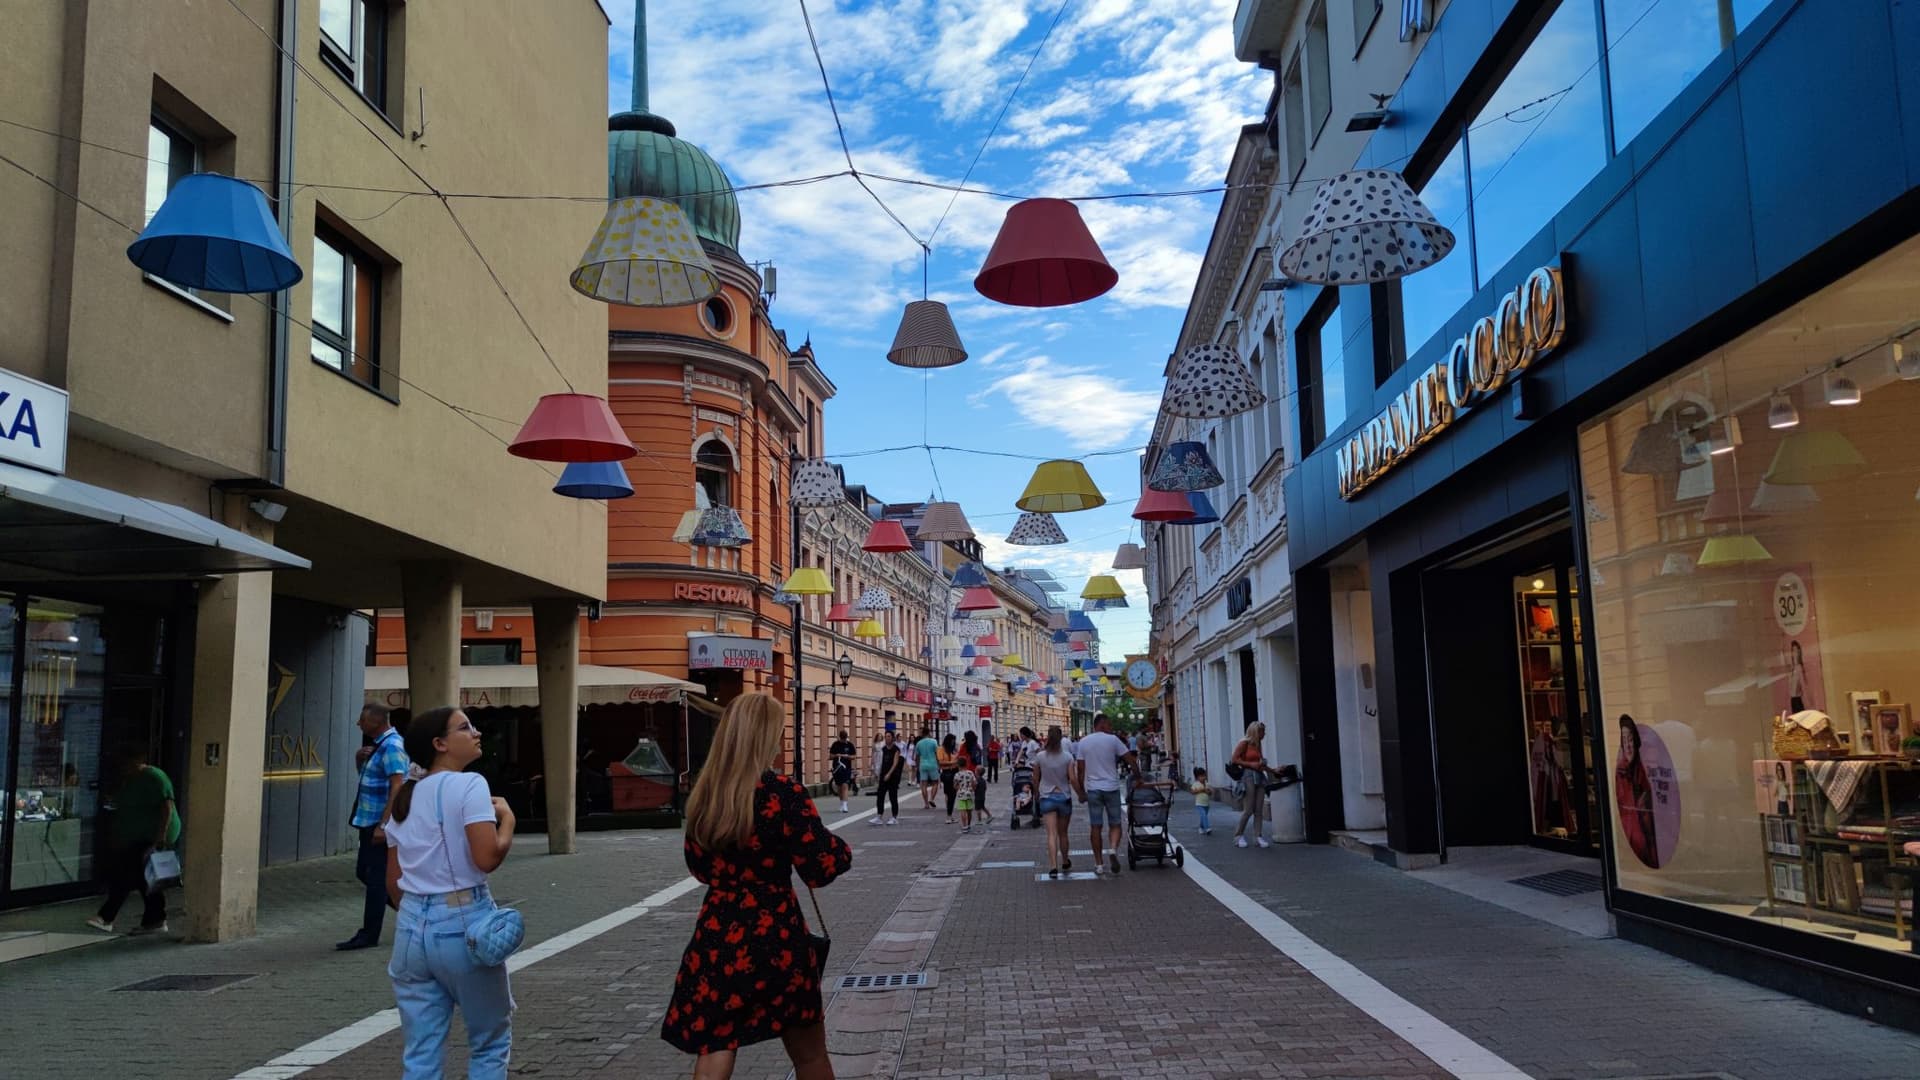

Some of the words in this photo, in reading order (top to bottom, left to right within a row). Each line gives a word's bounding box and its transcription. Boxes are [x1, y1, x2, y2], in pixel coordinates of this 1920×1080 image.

[1336, 362, 1453, 500] MADAME
[1447, 266, 1564, 409] COCO
[675, 583, 753, 608] RESTORAN
[722, 647, 767, 659] CITADELA
[723, 656, 767, 667] RESTORAN
